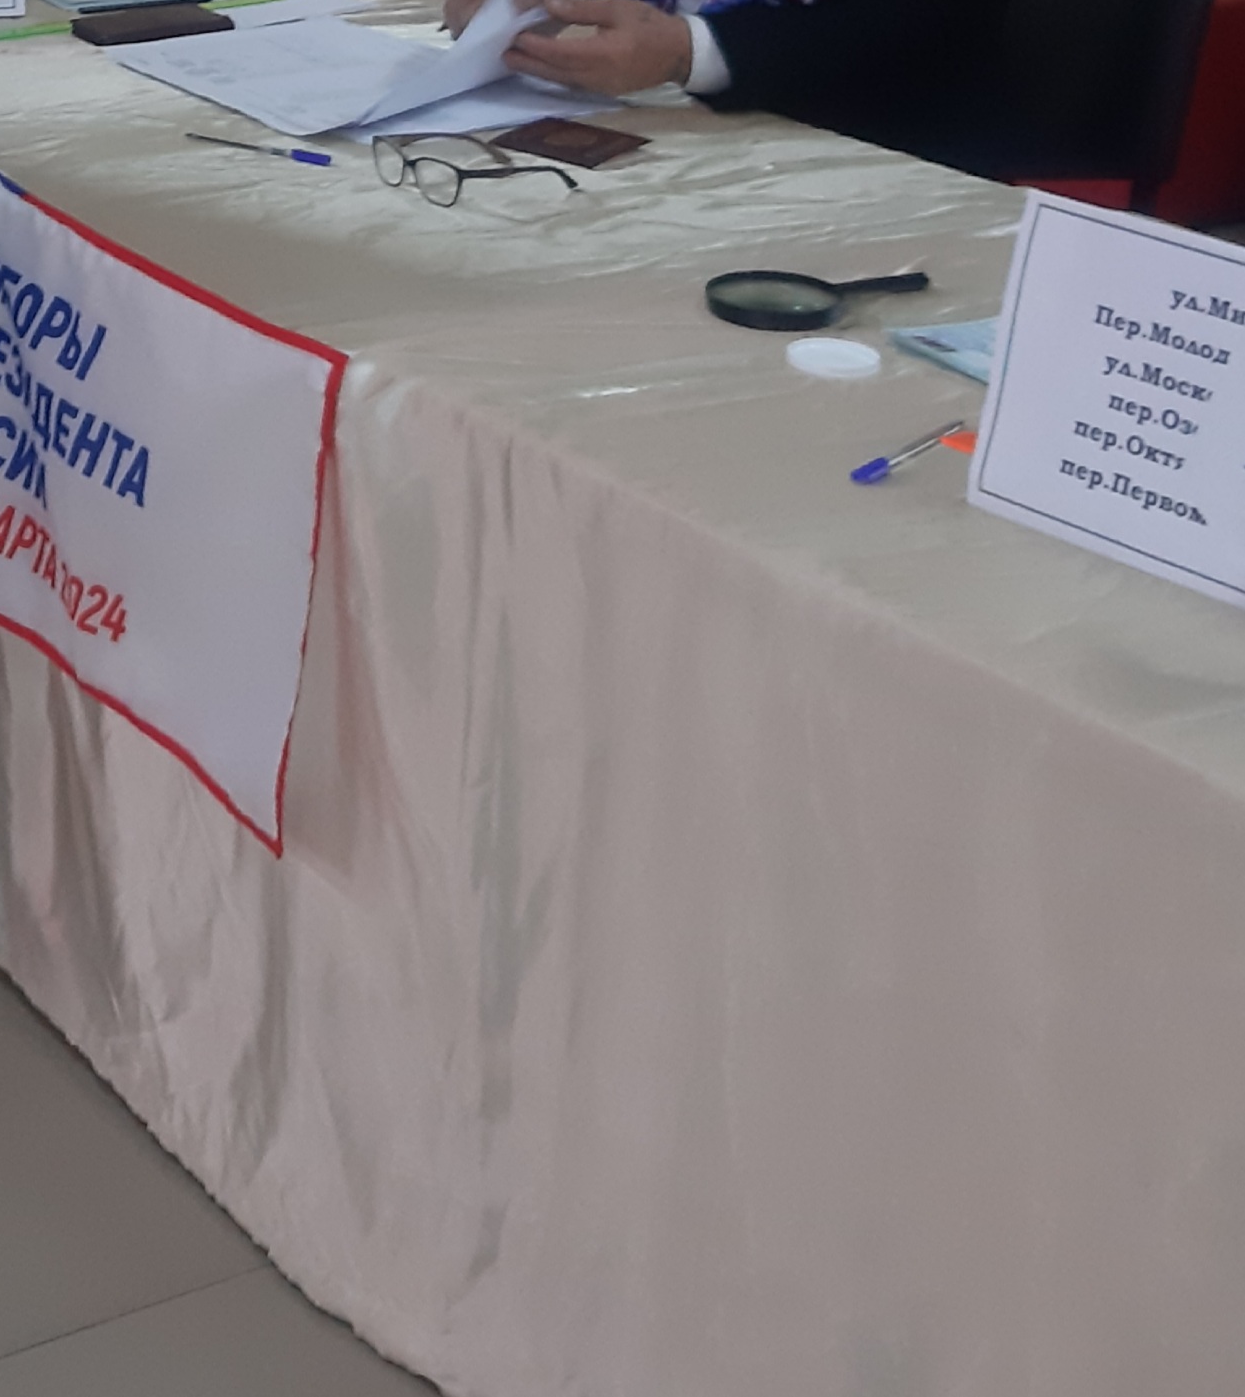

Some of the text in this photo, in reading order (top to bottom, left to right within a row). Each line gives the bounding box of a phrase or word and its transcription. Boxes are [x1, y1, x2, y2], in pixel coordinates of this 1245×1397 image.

[1094, 304, 1232, 366] Пер.Молод
[1101, 356, 1214, 403] ул.Моск
[1108, 394, 1200, 436] пер.Оз
